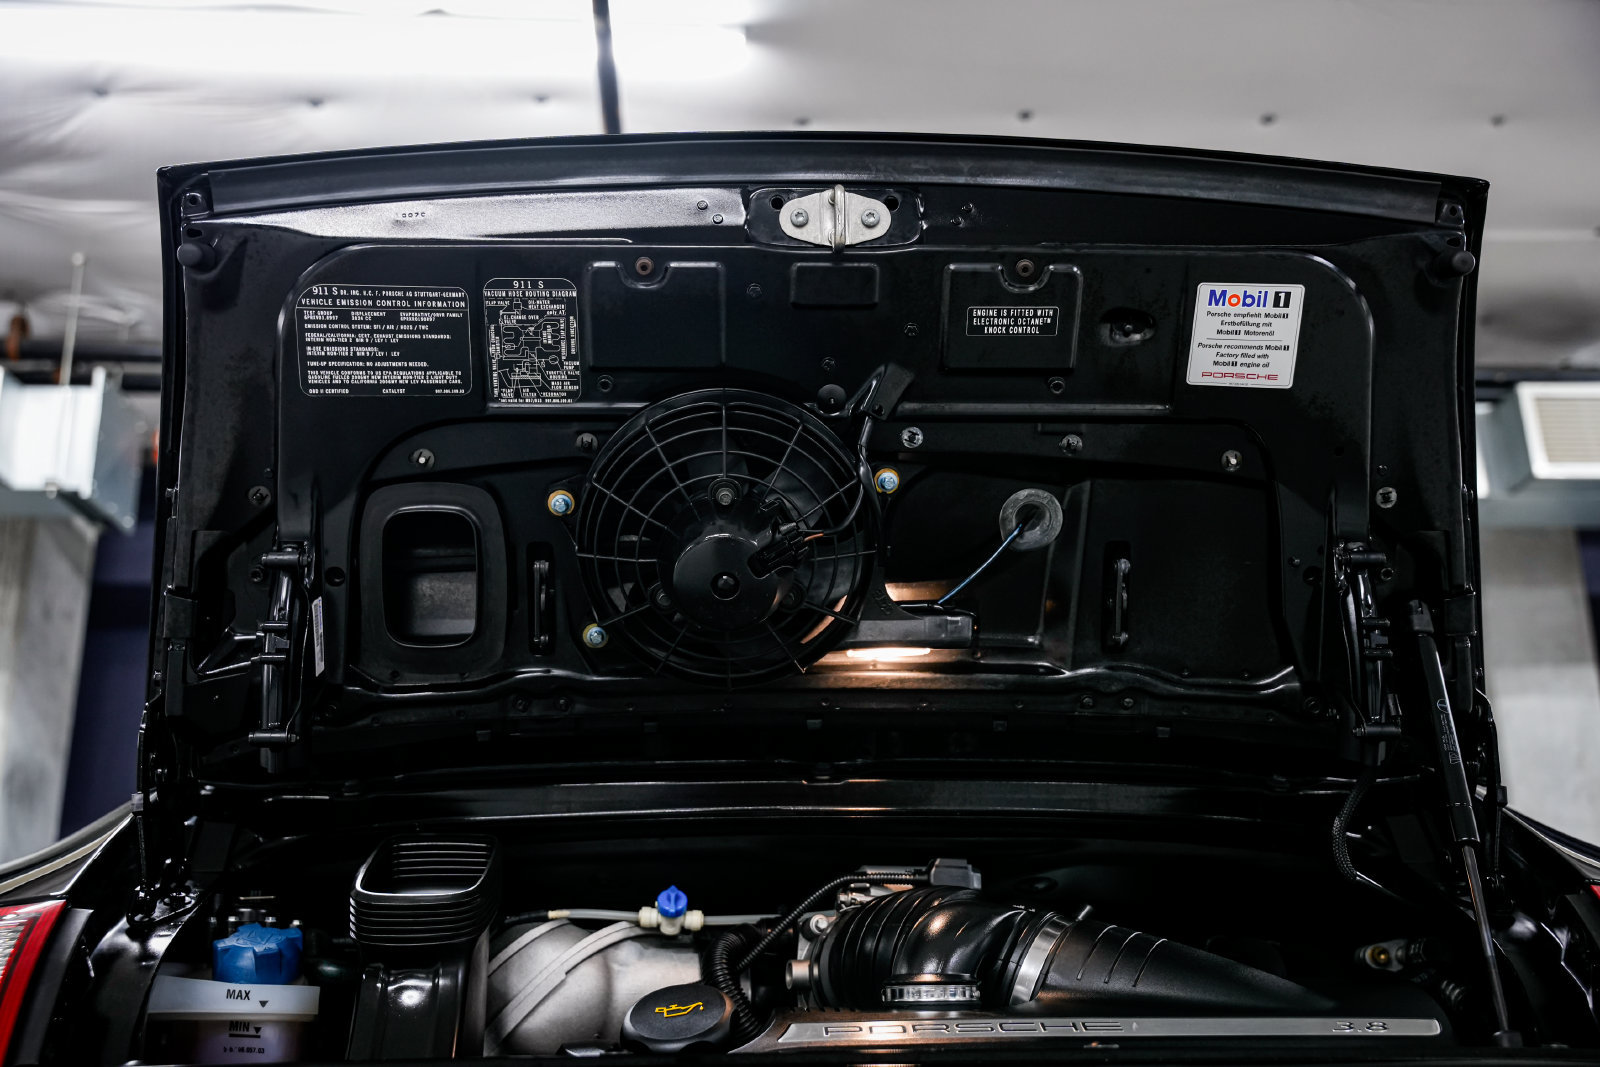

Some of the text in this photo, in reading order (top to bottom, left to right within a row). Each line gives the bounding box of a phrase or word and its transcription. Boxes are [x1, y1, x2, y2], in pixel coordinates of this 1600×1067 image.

[538, 281, 544, 289] S
[312, 287, 328, 295] 911
[333, 287, 338, 295] S
[1208, 290, 1288, 308] Mobil 1
[414, 300, 465, 308] INFORMATION
[1221, 320, 1260, 328] Erstbefüllung
[984, 326, 1040, 334] KNOCK CONTROL
[1202, 372, 1279, 380] PORSCHE
[226, 989, 251, 1000] MAX
[229, 1021, 249, 1032] MIN
[824, 1021, 1388, 1036] PORSCHE 3.8
